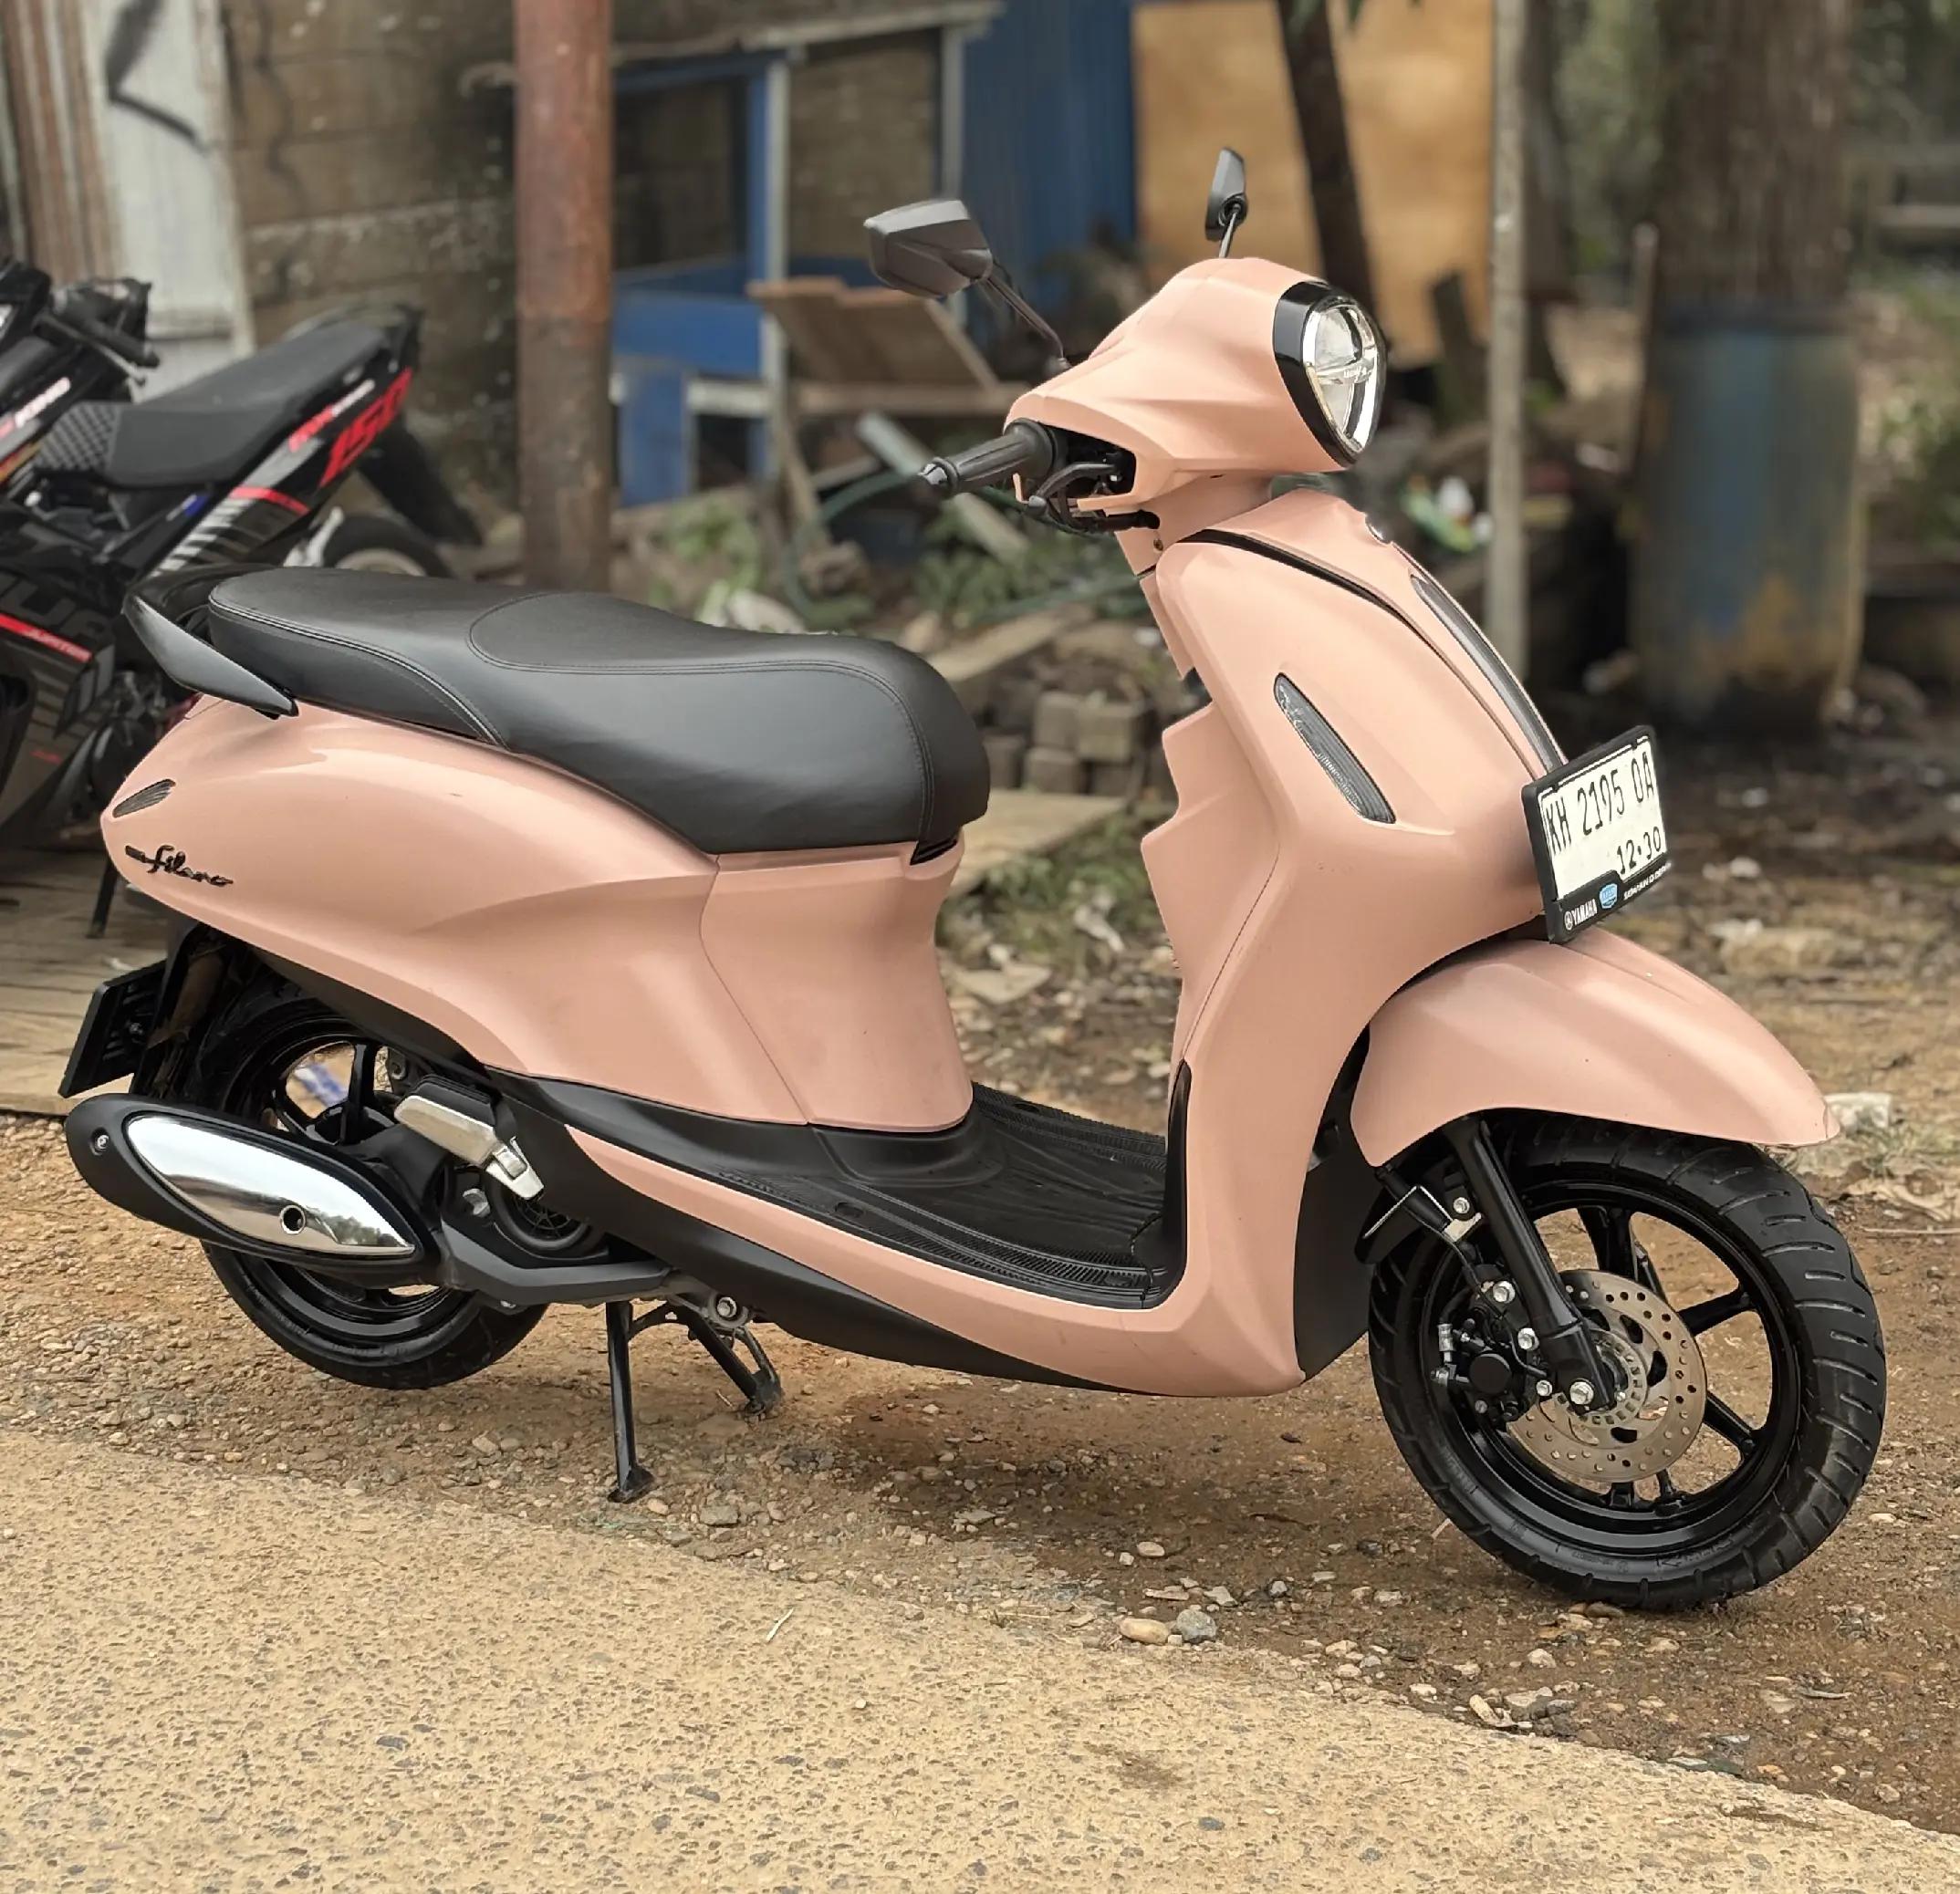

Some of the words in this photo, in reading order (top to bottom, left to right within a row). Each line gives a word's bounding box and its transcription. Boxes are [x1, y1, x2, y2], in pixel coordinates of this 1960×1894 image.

[1545, 796, 1571, 855] KH
[1577, 769, 1624, 836] 2195
[1631, 751, 1654, 803] OA
[1571, 898, 1598, 926] YAMAHA
